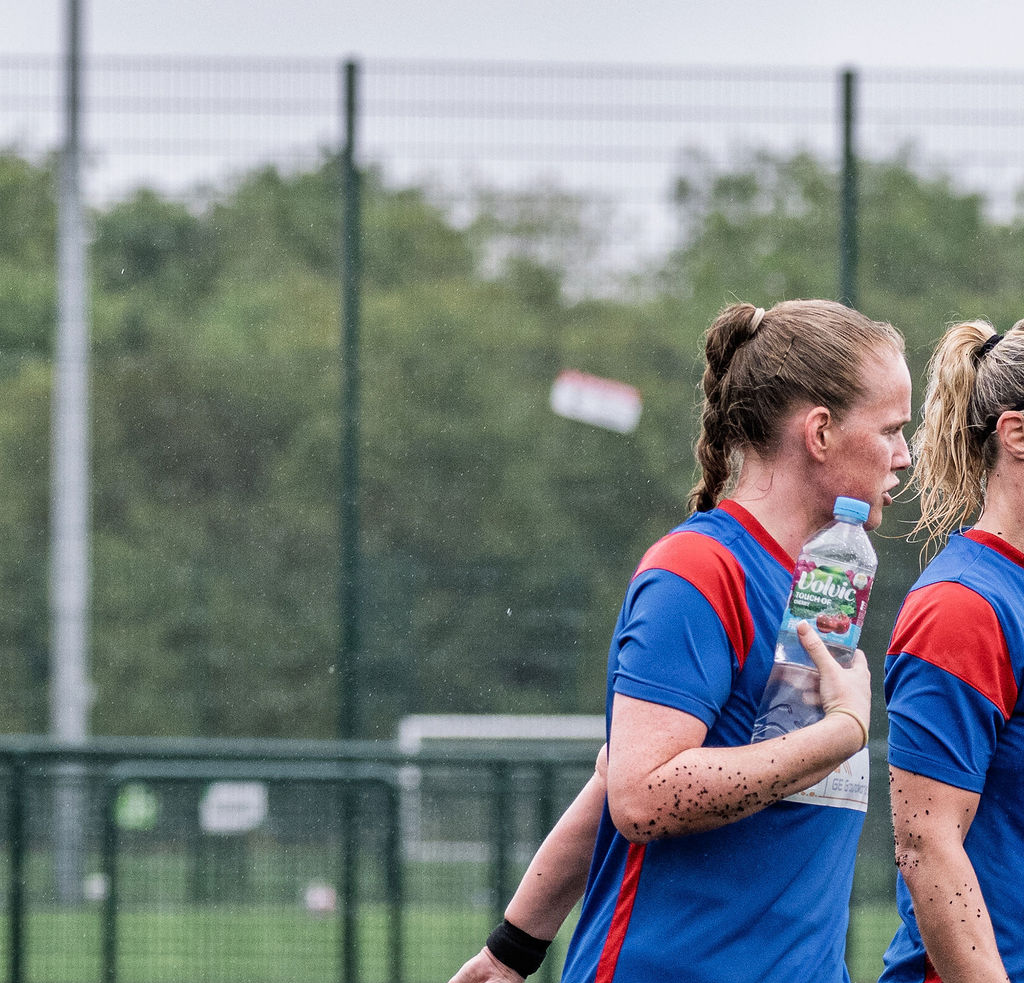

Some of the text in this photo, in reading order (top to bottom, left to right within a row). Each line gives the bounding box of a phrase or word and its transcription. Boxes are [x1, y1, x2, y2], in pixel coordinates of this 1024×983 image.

[798, 571, 857, 602] Volvic
[795, 591, 833, 606] TOUCH OF
